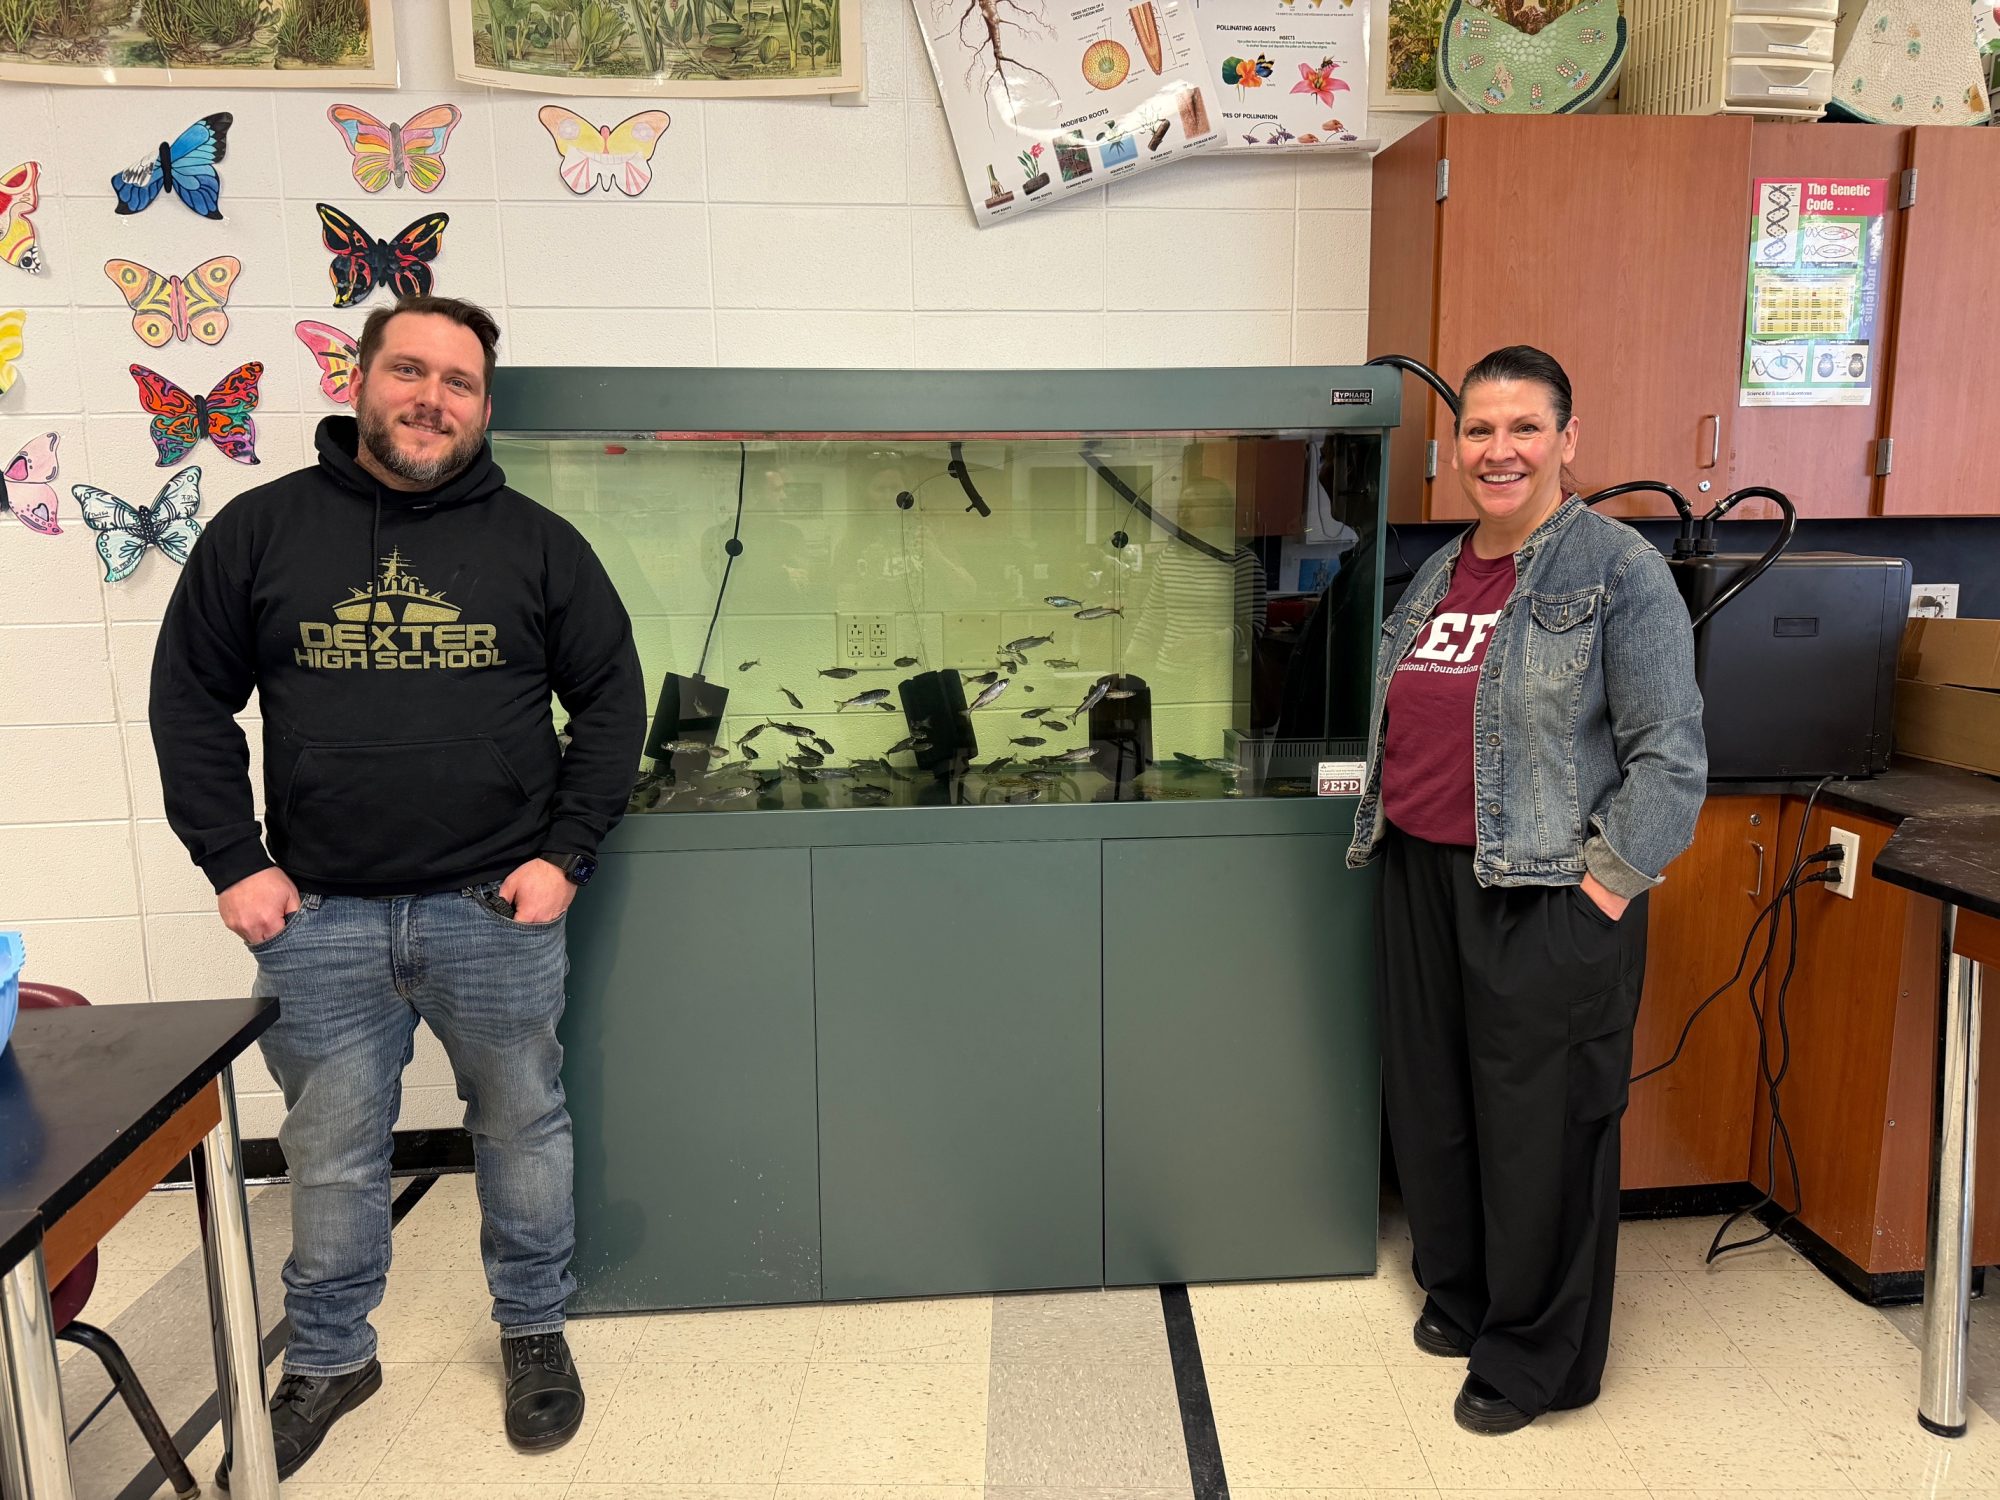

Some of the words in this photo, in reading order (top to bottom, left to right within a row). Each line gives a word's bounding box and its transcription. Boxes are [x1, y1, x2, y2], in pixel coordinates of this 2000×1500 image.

[1061, 116, 1088, 128] MODIFIED
[1089, 108, 1109, 119] ROOTS
[1808, 183, 1827, 196] The
[1830, 184, 1870, 196] Genetic
[1806, 199, 1833, 211] Code
[299, 622, 497, 650] DEXTER
[294, 648, 368, 669] HIGH
[375, 648, 506, 669] SCHOOL
[1397, 662, 1428, 671] cational
[1429, 663, 1478, 674] Foundation
[1330, 781, 1359, 791] EFD
